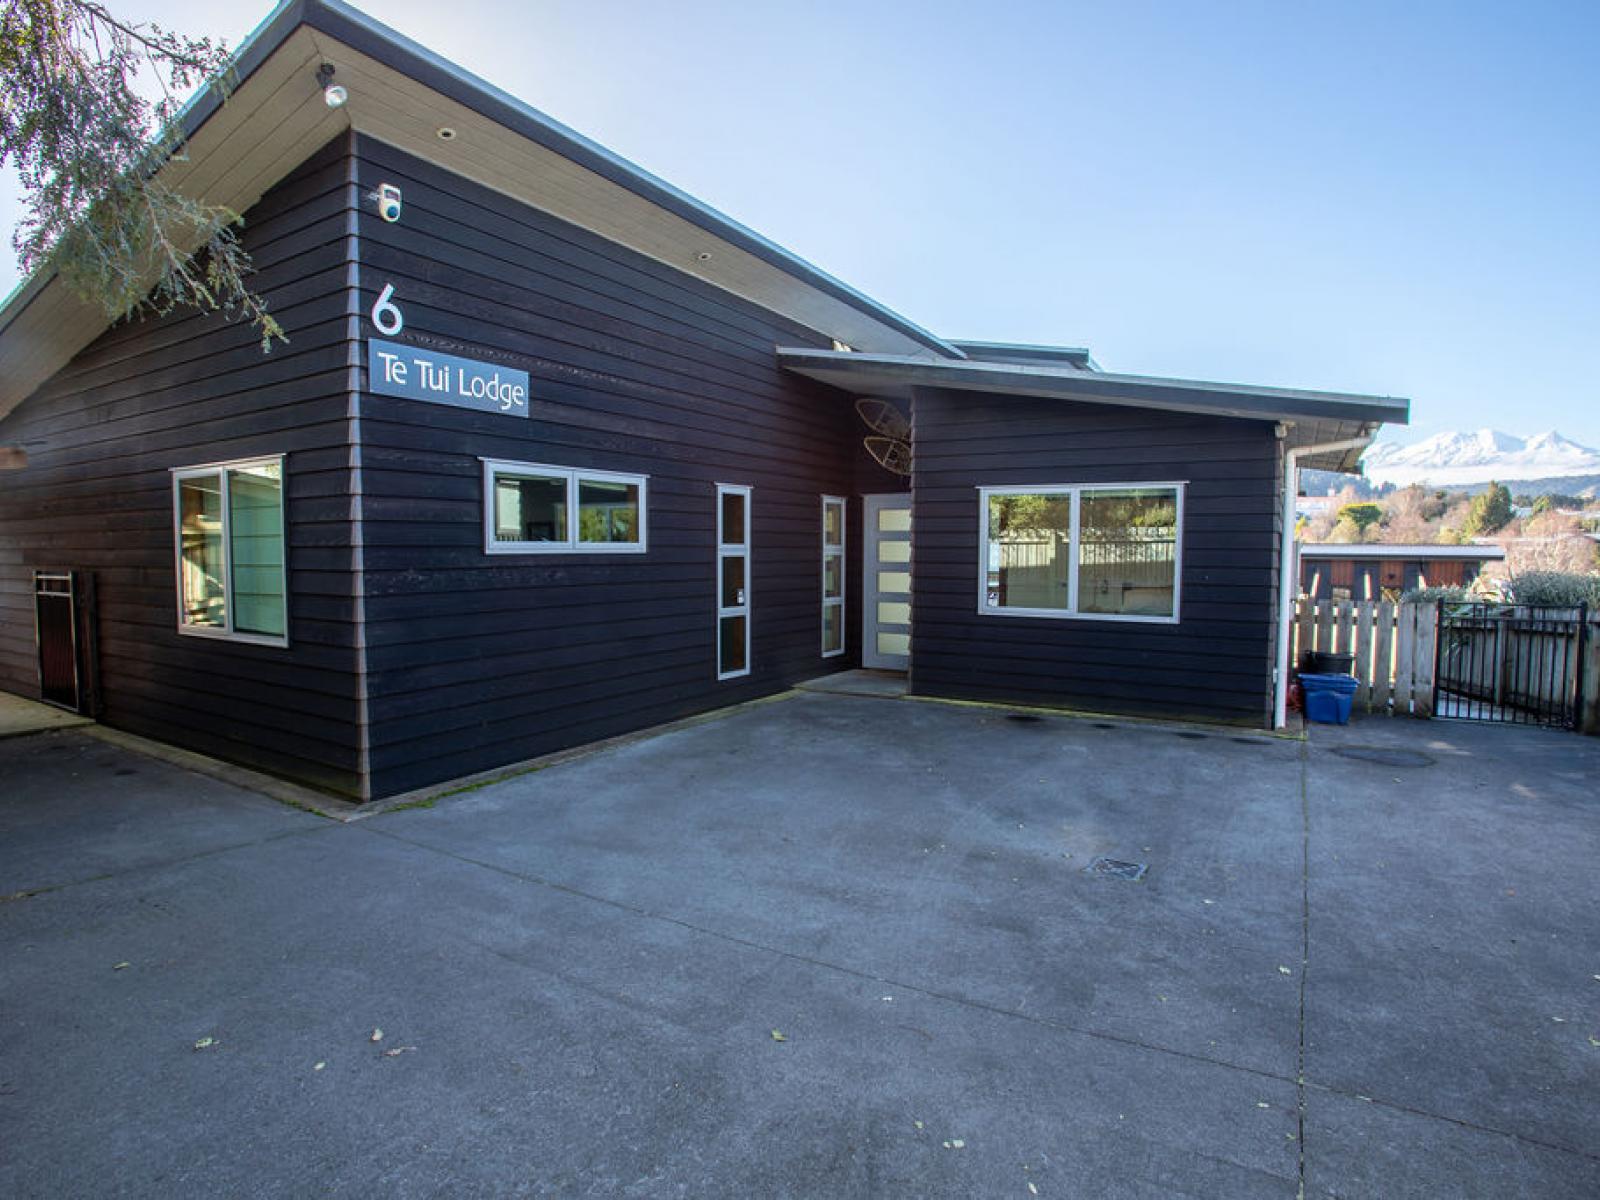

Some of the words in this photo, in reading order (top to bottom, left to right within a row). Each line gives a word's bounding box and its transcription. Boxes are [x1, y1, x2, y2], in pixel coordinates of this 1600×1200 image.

[372, 283, 403, 336] 6
[377, 352, 407, 384] Te
[414, 359, 449, 392] Tui
[458, 368, 524, 410] Lodge
